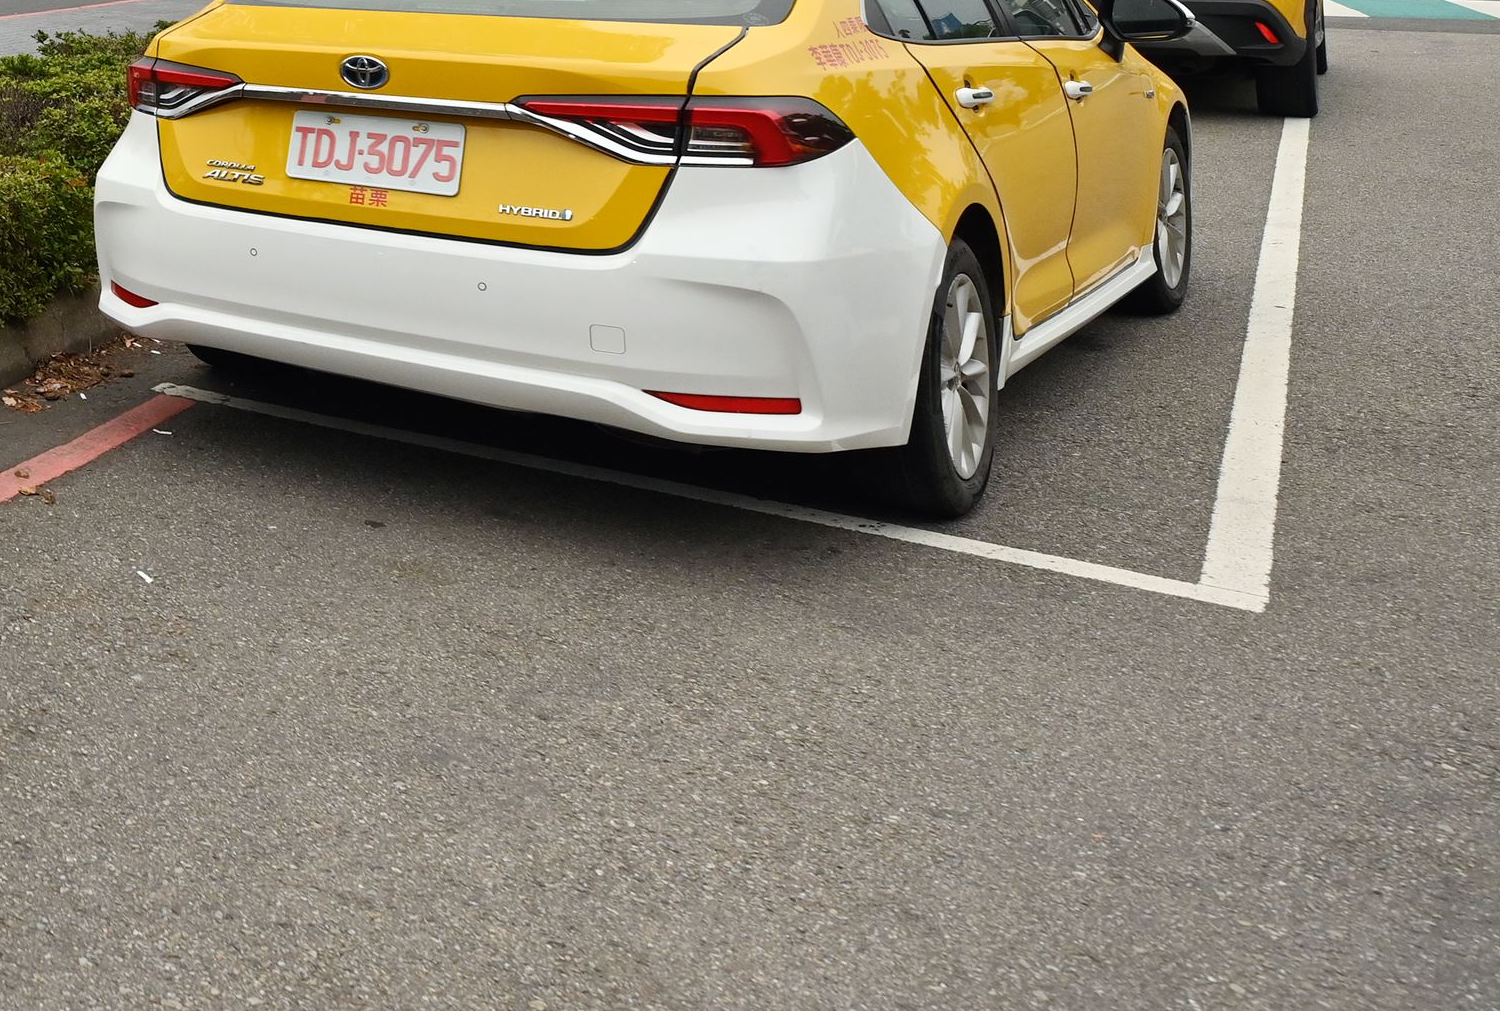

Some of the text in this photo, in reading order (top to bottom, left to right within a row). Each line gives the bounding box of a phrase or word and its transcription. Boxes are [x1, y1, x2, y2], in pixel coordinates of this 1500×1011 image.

[295, 126, 461, 183] TDJ-3075
[205, 159, 256, 172] COROLLA
[202, 169, 266, 185] ALTIS
[349, 187, 389, 208] 苗栗
[498, 203, 562, 220] HYBRID
